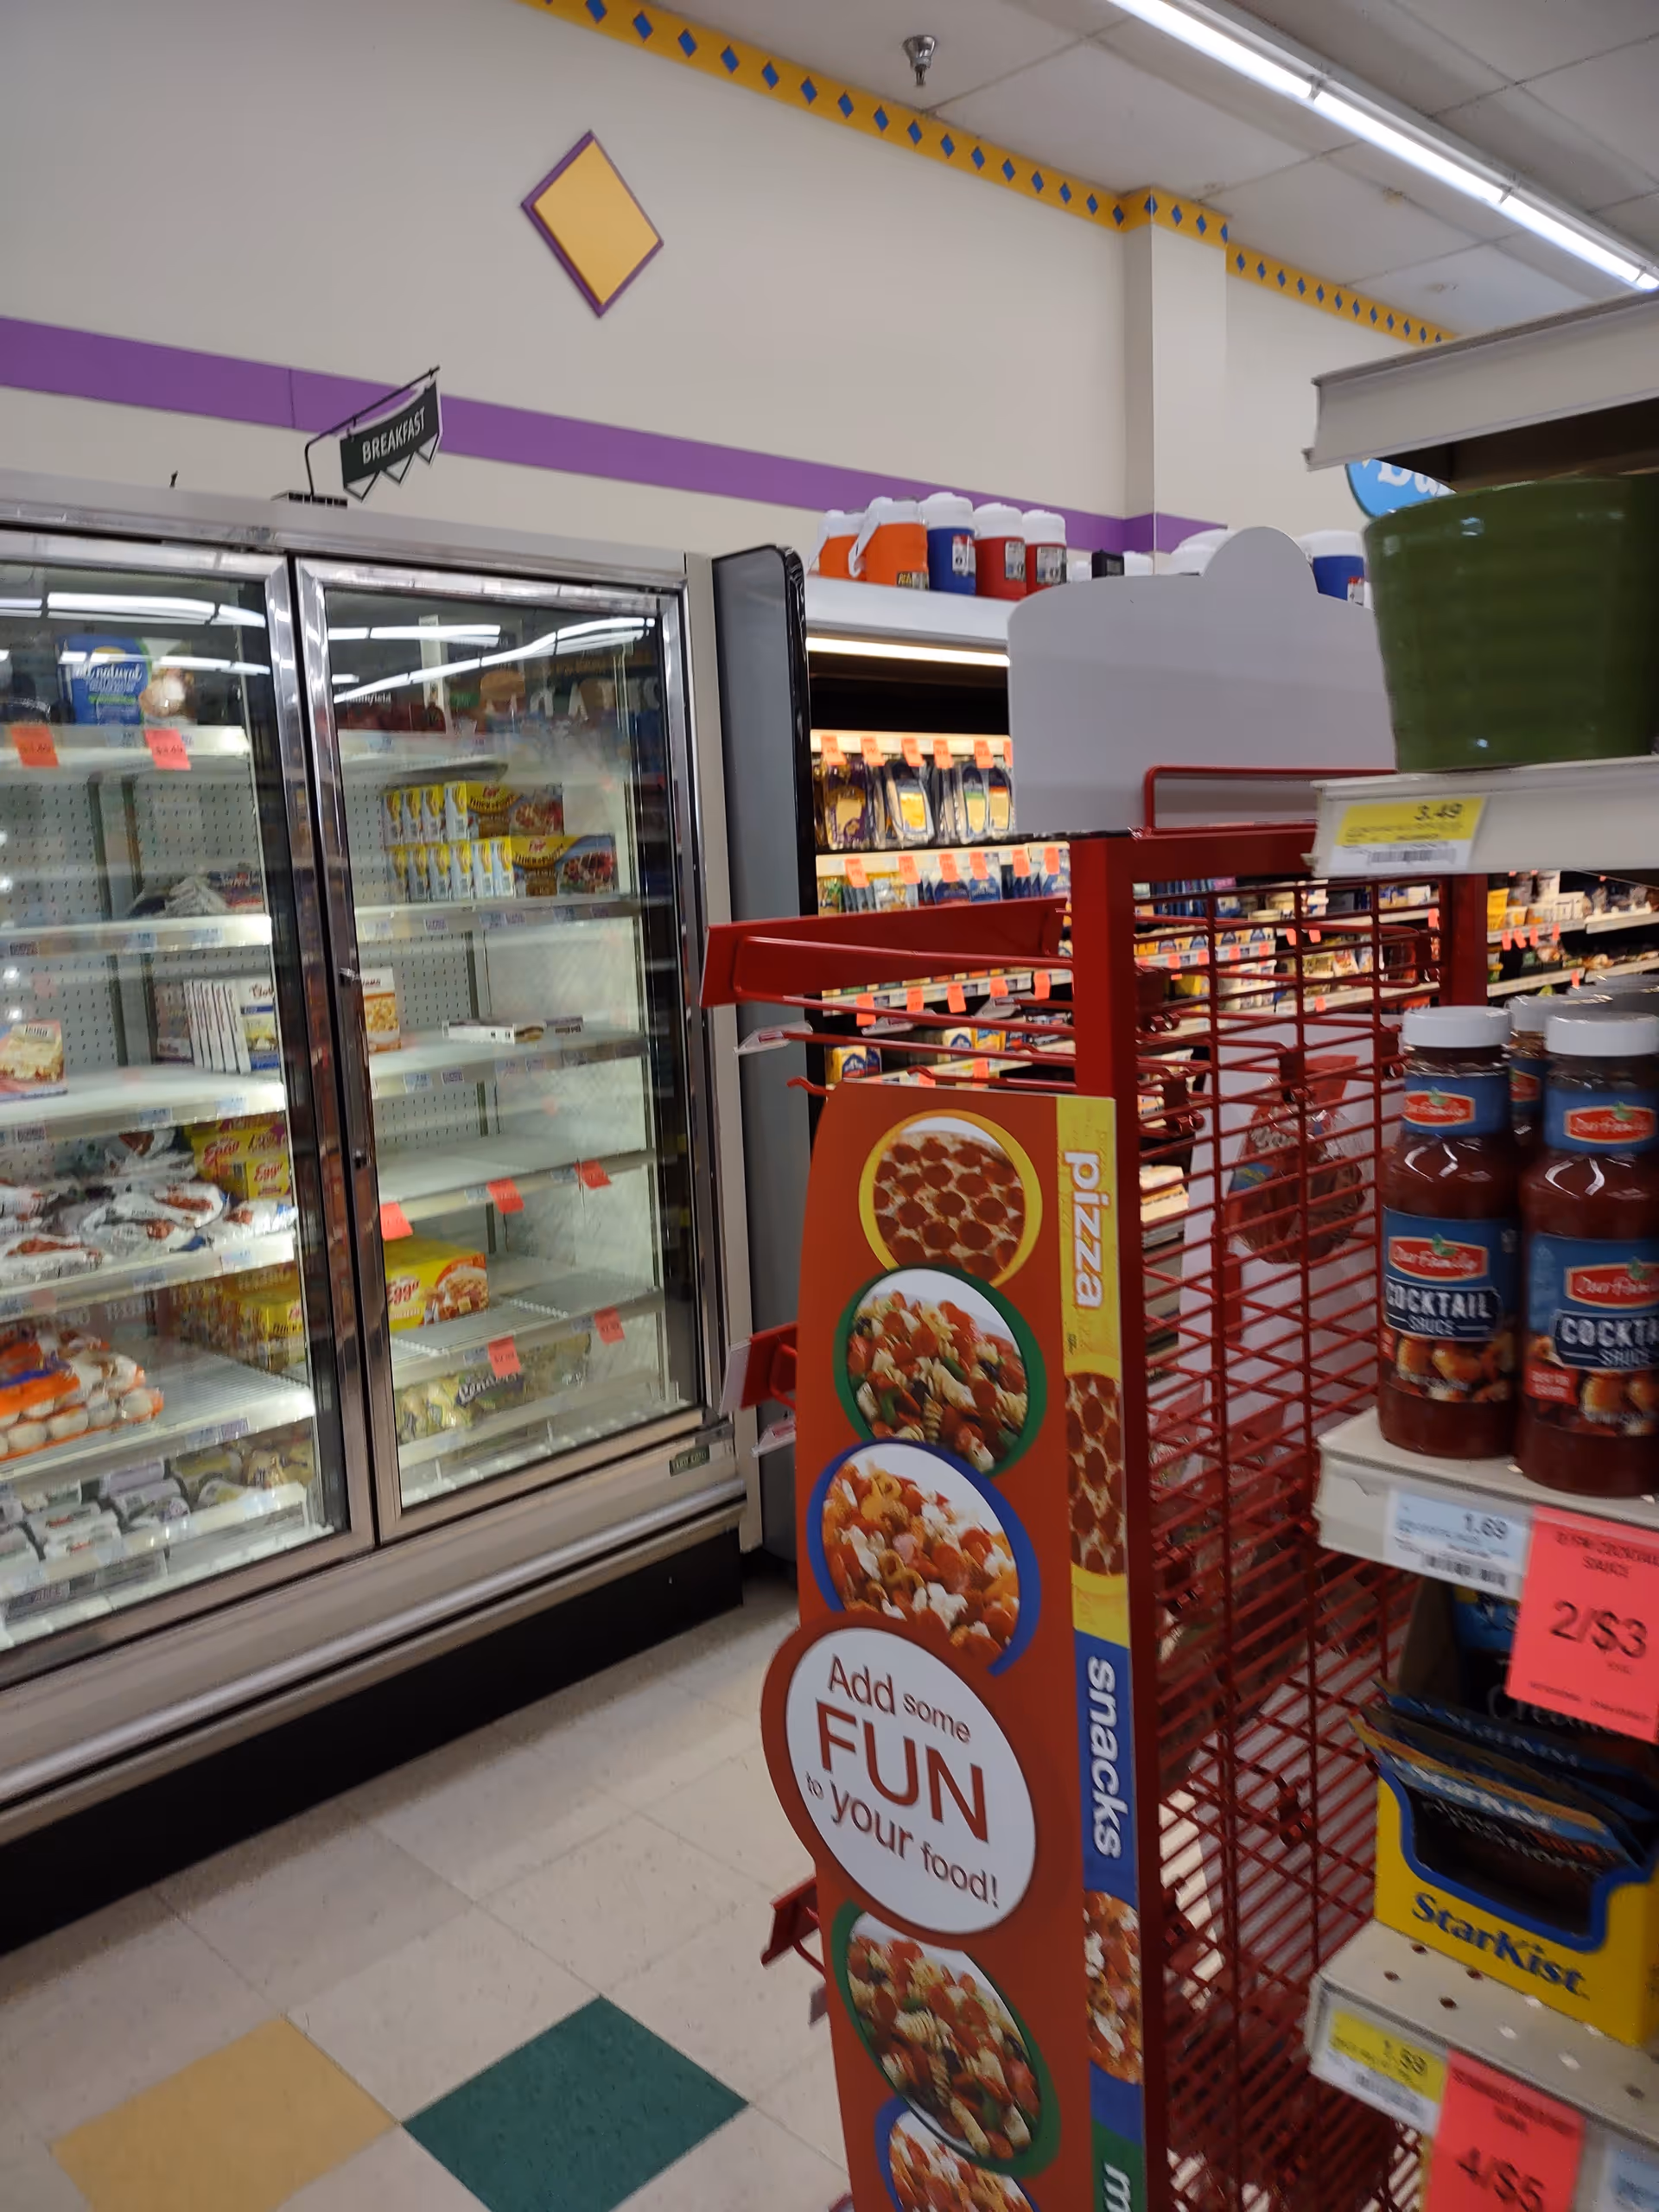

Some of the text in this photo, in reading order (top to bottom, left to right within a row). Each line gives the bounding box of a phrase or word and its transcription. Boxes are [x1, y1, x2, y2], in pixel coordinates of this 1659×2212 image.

[362, 406, 425, 465] BREAKFAST
[253, 1161, 283, 1183] Eggo
[1064, 1150, 1109, 1308] pizza
[1385, 1280, 1492, 1319] COCKTAIL
[1549, 1599, 1648, 1659] 2/$3
[828, 1653, 971, 1745] Add some
[816, 1698, 988, 1844] FUN
[1087, 1655, 1129, 1859] snacks
[805, 1771, 1000, 1910] to your food!
[1411, 1891, 1591, 2001] StarKist
